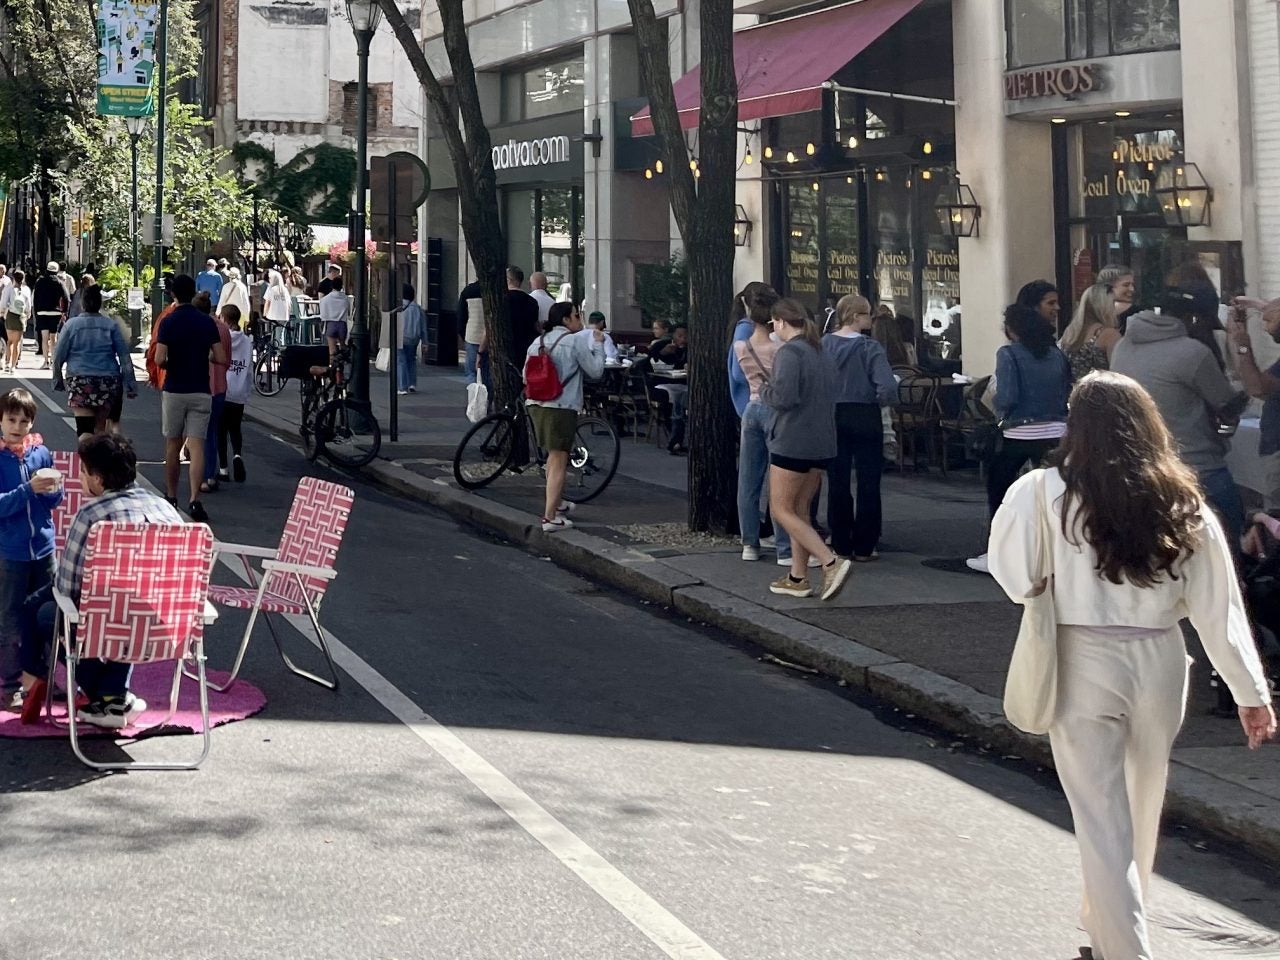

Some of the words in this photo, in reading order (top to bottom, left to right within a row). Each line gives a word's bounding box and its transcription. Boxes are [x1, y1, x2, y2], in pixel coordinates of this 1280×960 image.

[492, 135, 569, 171] aatva.com
[1116, 173, 1151, 198] Oven
[831, 249, 858, 264] Pietro's
[877, 249, 907, 265] Pietro's
[926, 248, 959, 265] Pietro's
[944, 267, 959, 281] Ove
